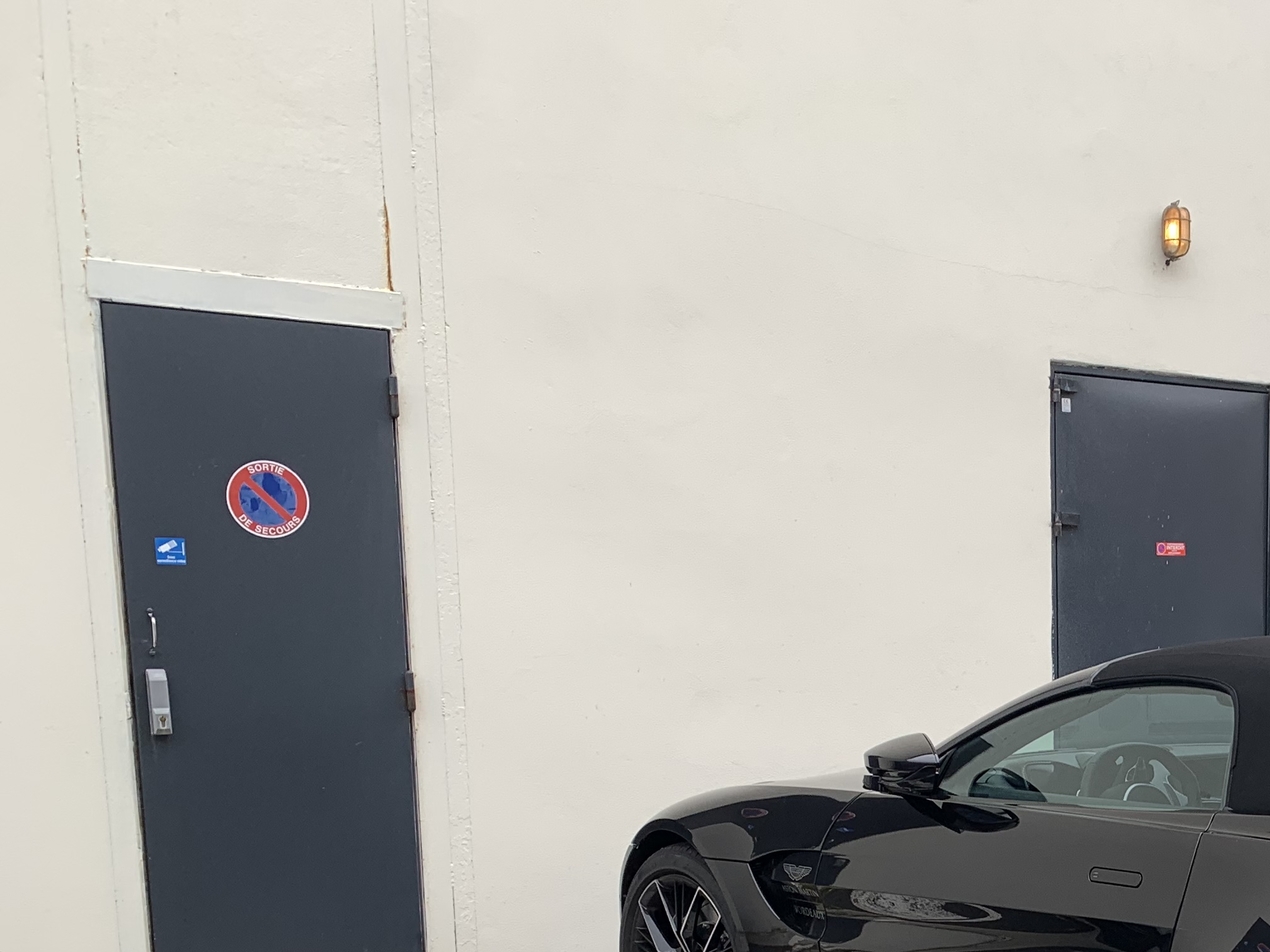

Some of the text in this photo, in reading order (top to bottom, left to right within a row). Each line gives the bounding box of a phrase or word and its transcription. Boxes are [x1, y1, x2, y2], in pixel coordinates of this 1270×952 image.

[247, 463, 285, 476] SORTIE
[238, 513, 301, 536] DE SECOURS
